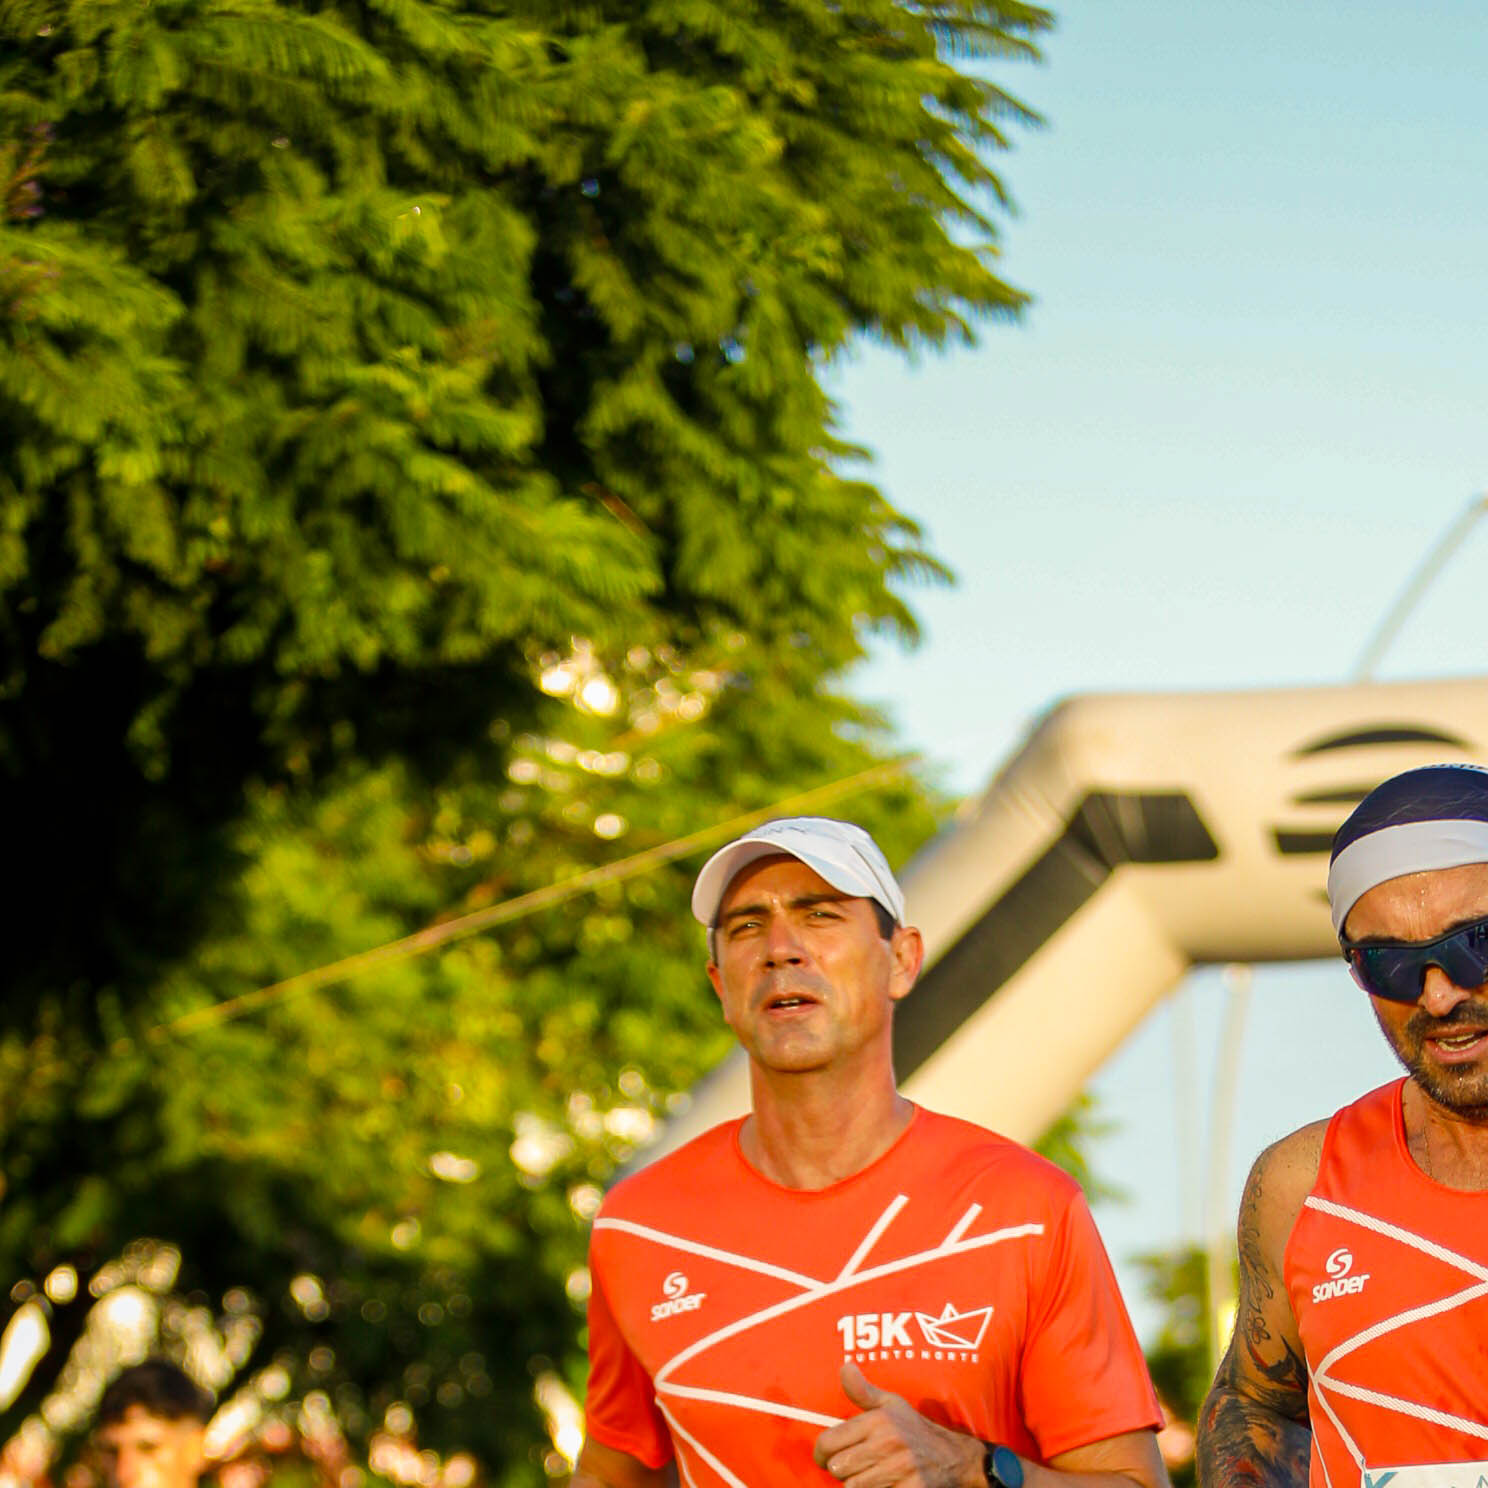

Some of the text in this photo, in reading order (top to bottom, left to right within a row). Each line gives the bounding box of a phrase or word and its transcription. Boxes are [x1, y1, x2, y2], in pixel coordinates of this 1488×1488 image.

[837, 1311, 913, 1351] 15K
[844, 1349, 979, 1364] PUERTO NORTE
